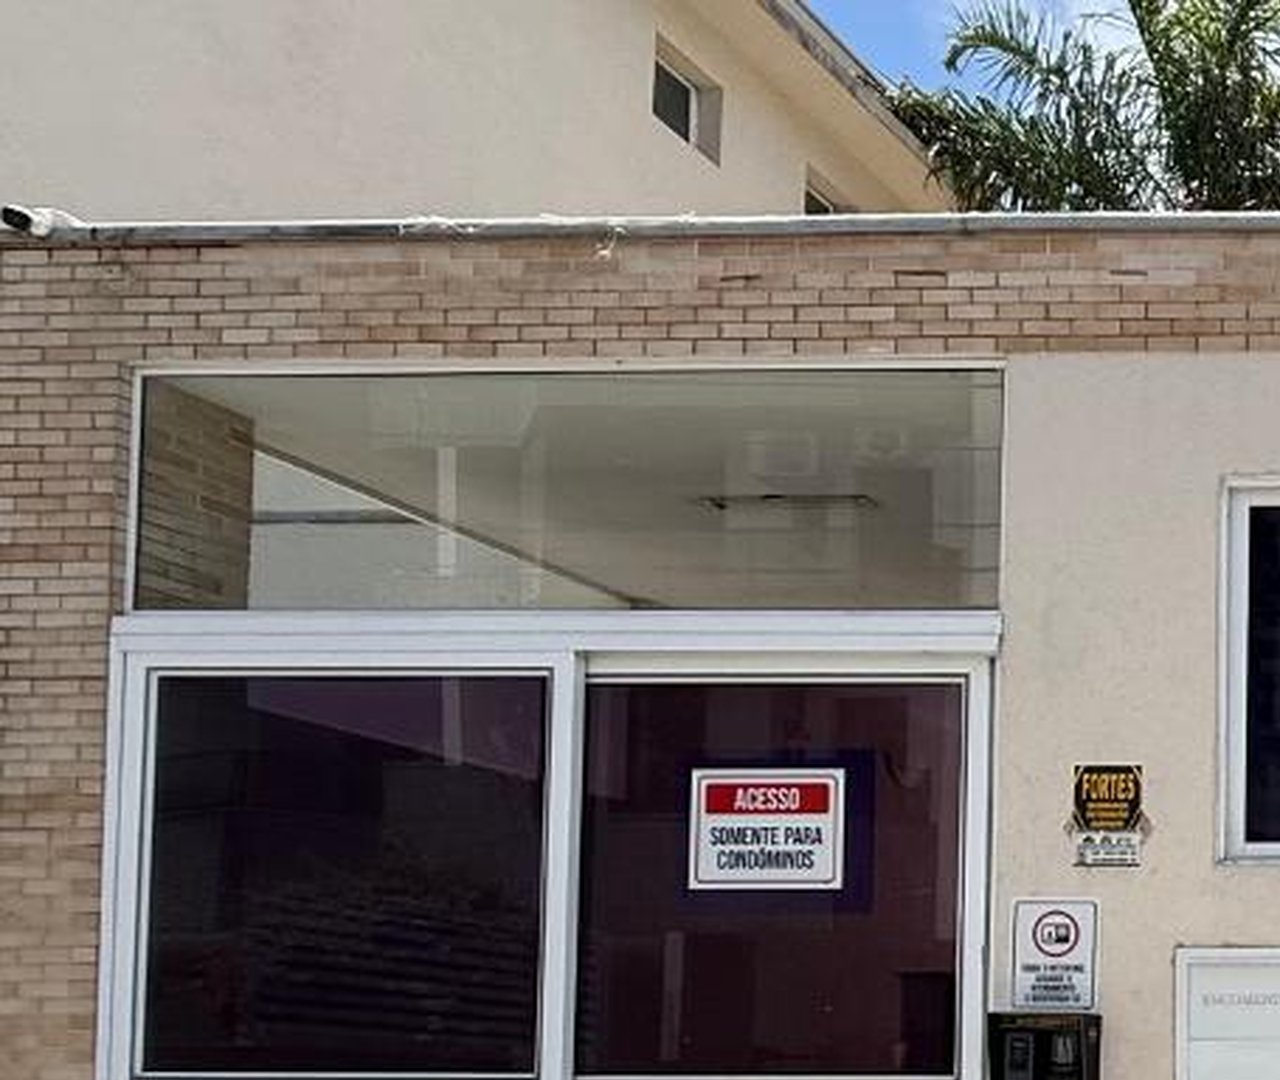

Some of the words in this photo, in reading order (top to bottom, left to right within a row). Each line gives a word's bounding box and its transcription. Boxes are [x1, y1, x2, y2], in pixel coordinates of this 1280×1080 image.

[1082, 773, 1136, 800] FORTES
[734, 787, 800, 811] ACESSO
[710, 827, 780, 846] SOMENTE
[784, 827, 823, 845] PARA
